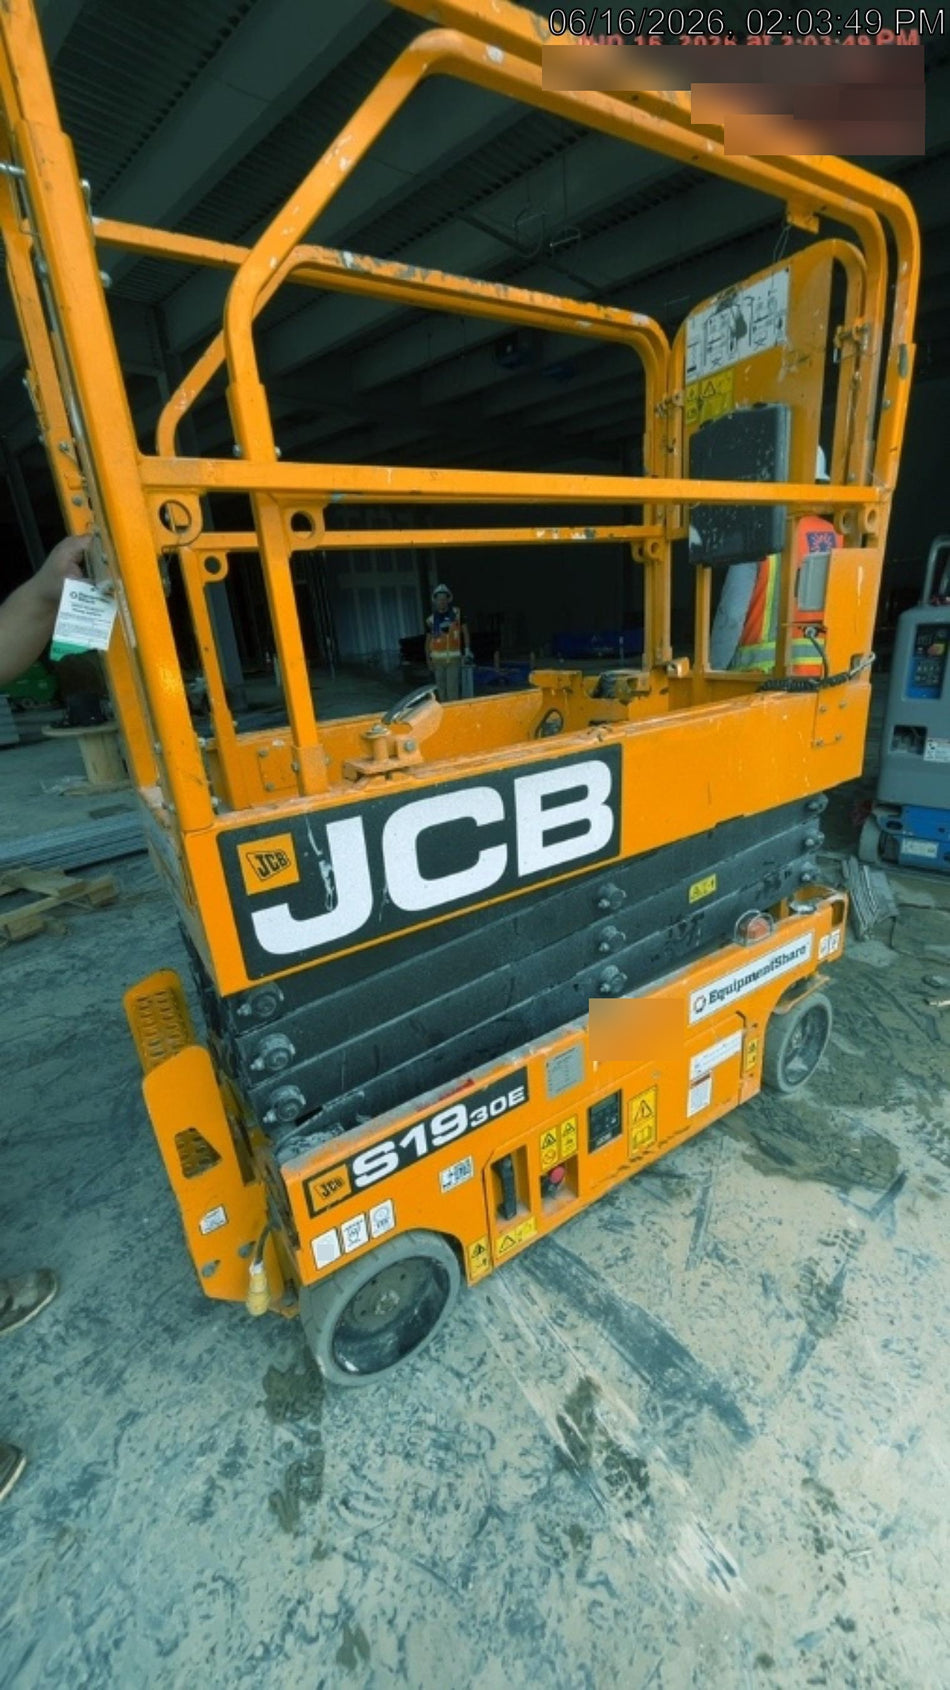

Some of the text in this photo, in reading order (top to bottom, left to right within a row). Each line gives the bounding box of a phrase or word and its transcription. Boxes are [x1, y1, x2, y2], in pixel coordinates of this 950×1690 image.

[251, 759, 614, 955] JCB
[256, 849, 289, 877] JCB
[708, 944, 807, 1005] EquipmentShare
